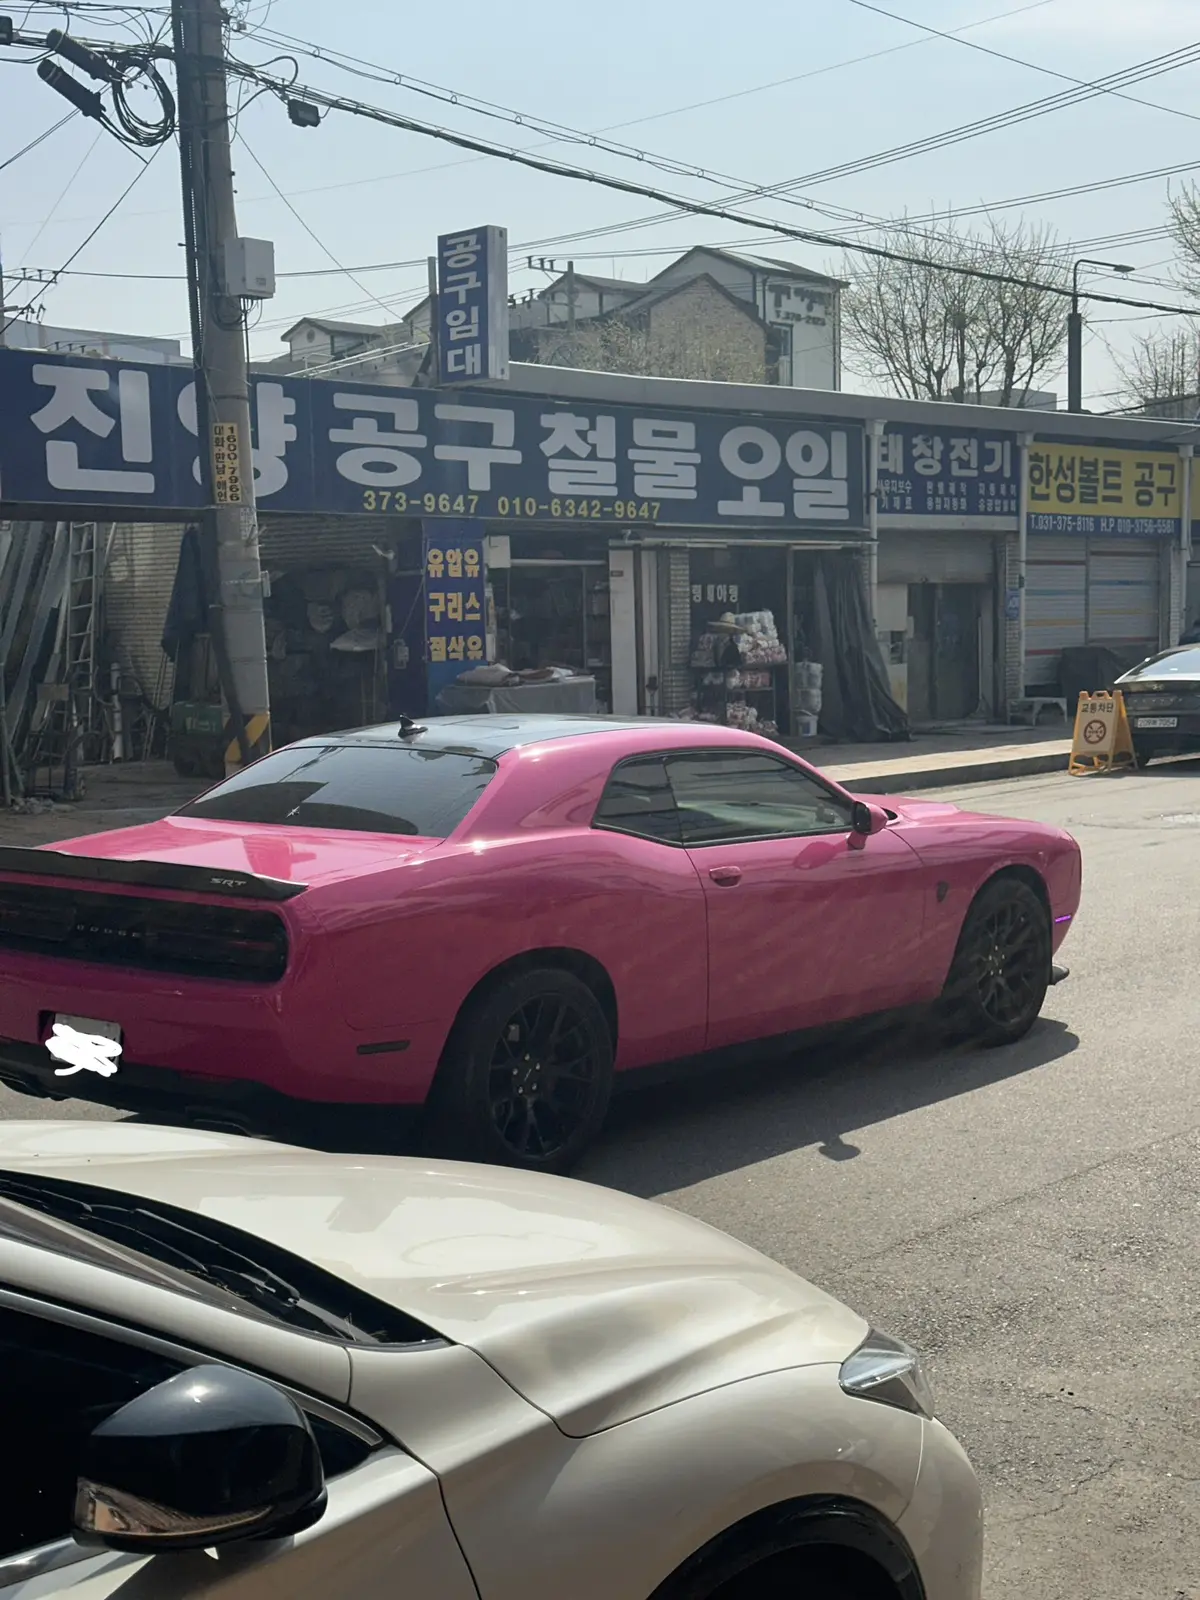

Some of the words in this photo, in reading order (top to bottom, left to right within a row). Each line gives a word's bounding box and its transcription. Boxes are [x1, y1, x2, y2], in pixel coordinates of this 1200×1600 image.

[442, 234, 482, 375] 공구임대
[876, 433, 1012, 479] 태창전기
[1028, 452, 1123, 504] 한성볼트
[1133, 461, 1177, 507] 공구
[363, 490, 480, 514] 373-9647
[497, 498, 662, 520] 010-6342-9647
[427, 548, 480, 578] 유압유
[429, 591, 481, 621] 구리스
[1081, 702, 1114, 713] 교통차단
[210, 877, 247, 888] SRT
